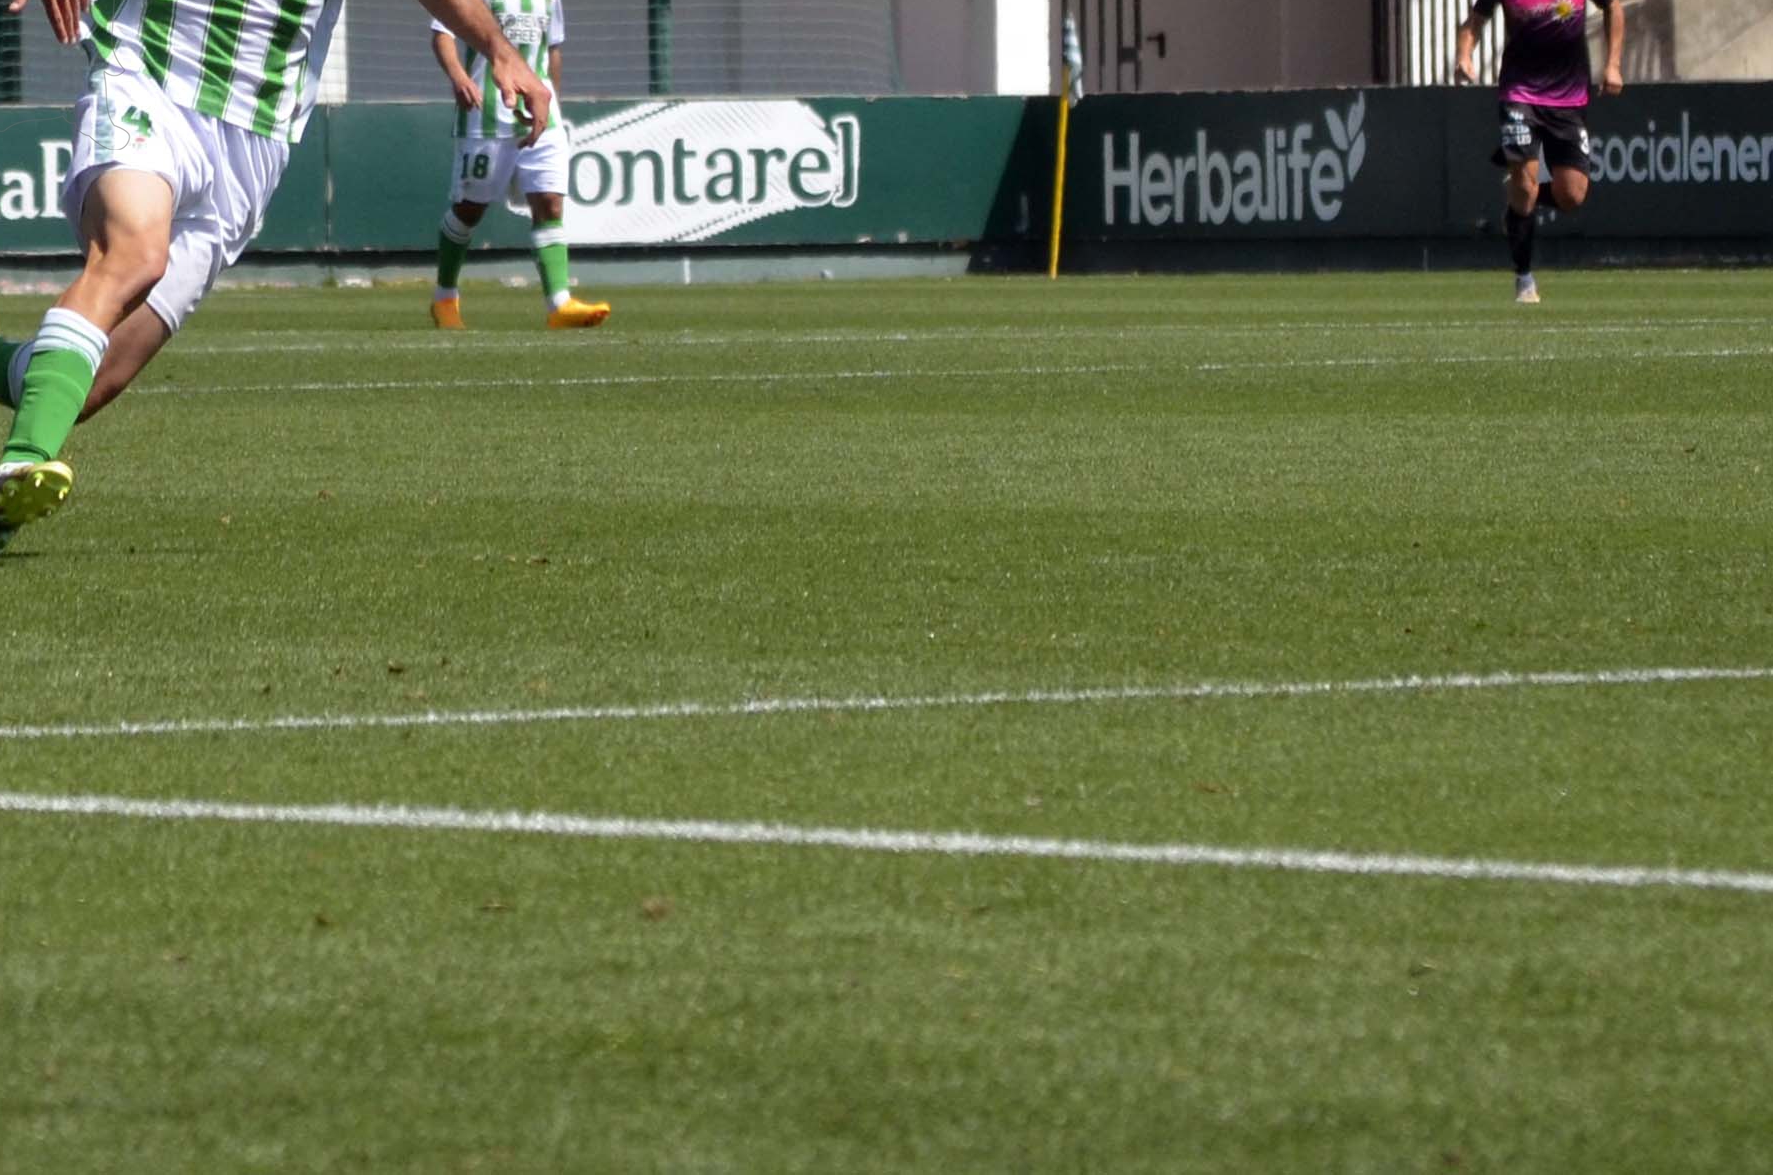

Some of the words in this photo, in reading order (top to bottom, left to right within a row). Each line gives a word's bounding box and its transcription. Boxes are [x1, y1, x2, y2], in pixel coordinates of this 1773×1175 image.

[121, 105, 153, 138] 4
[1589, 111, 1773, 182] socialener
[460, 153, 490, 179] 18
[568, 121, 855, 207] ontarel
[1103, 122, 1345, 225] Herbalife
